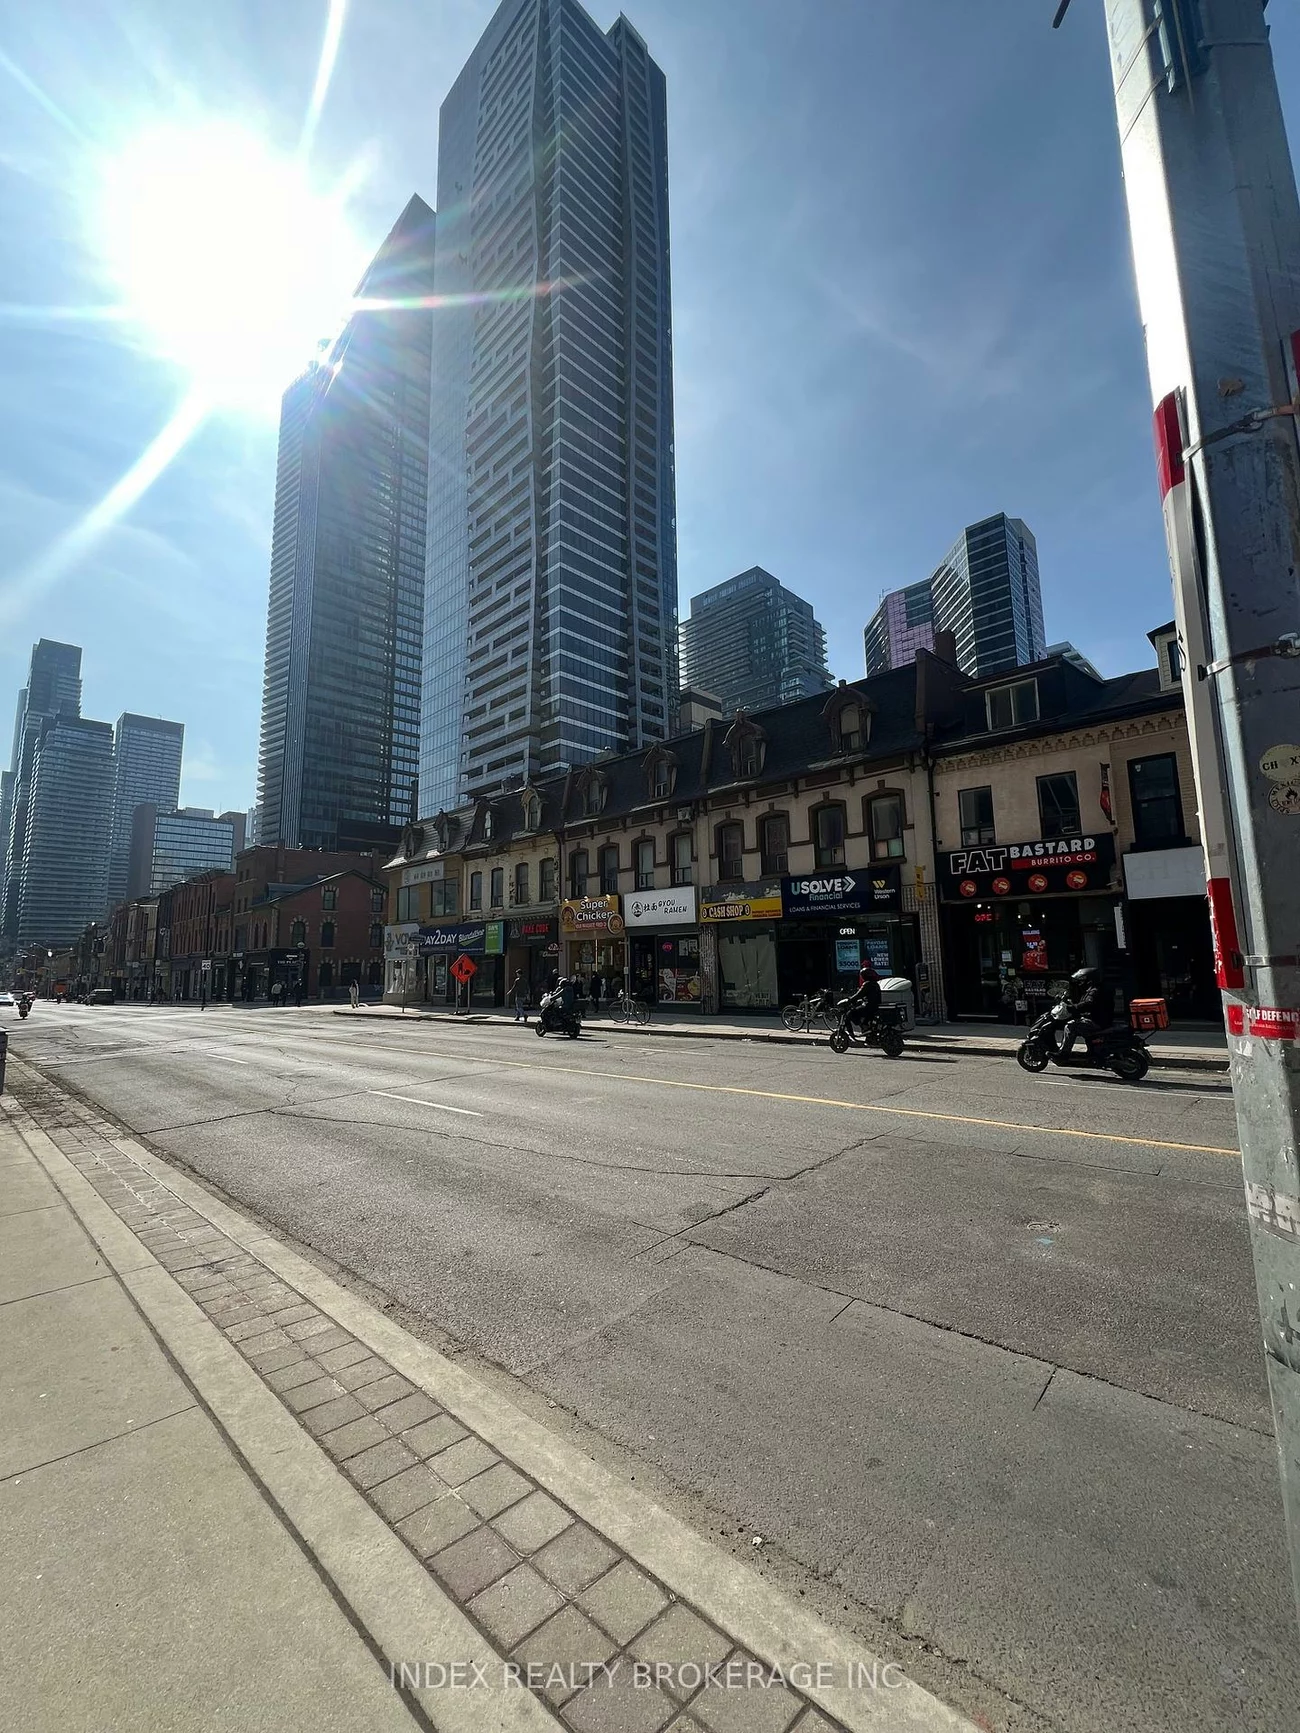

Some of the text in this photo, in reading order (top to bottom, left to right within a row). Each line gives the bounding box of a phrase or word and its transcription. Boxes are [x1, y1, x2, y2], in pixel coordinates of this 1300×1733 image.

[950, 837, 1096, 875] FAT BASTARD
[1031, 853, 1095, 866] BURRITO CO.
[791, 878, 842, 895] USOLVE
[809, 891, 843, 901] Financial
[580, 900, 608, 910] Super
[664, 906, 688, 914] RAMEN
[810, 903, 837, 911] FINANCIAL
[837, 902, 861, 910] SERVICES
[708, 905, 726, 918] CASH
[726, 904, 743, 917] SHOP
[839, 927, 856, 935] OPEN
[1261, 1009, 1300, 1023] DEFENC
